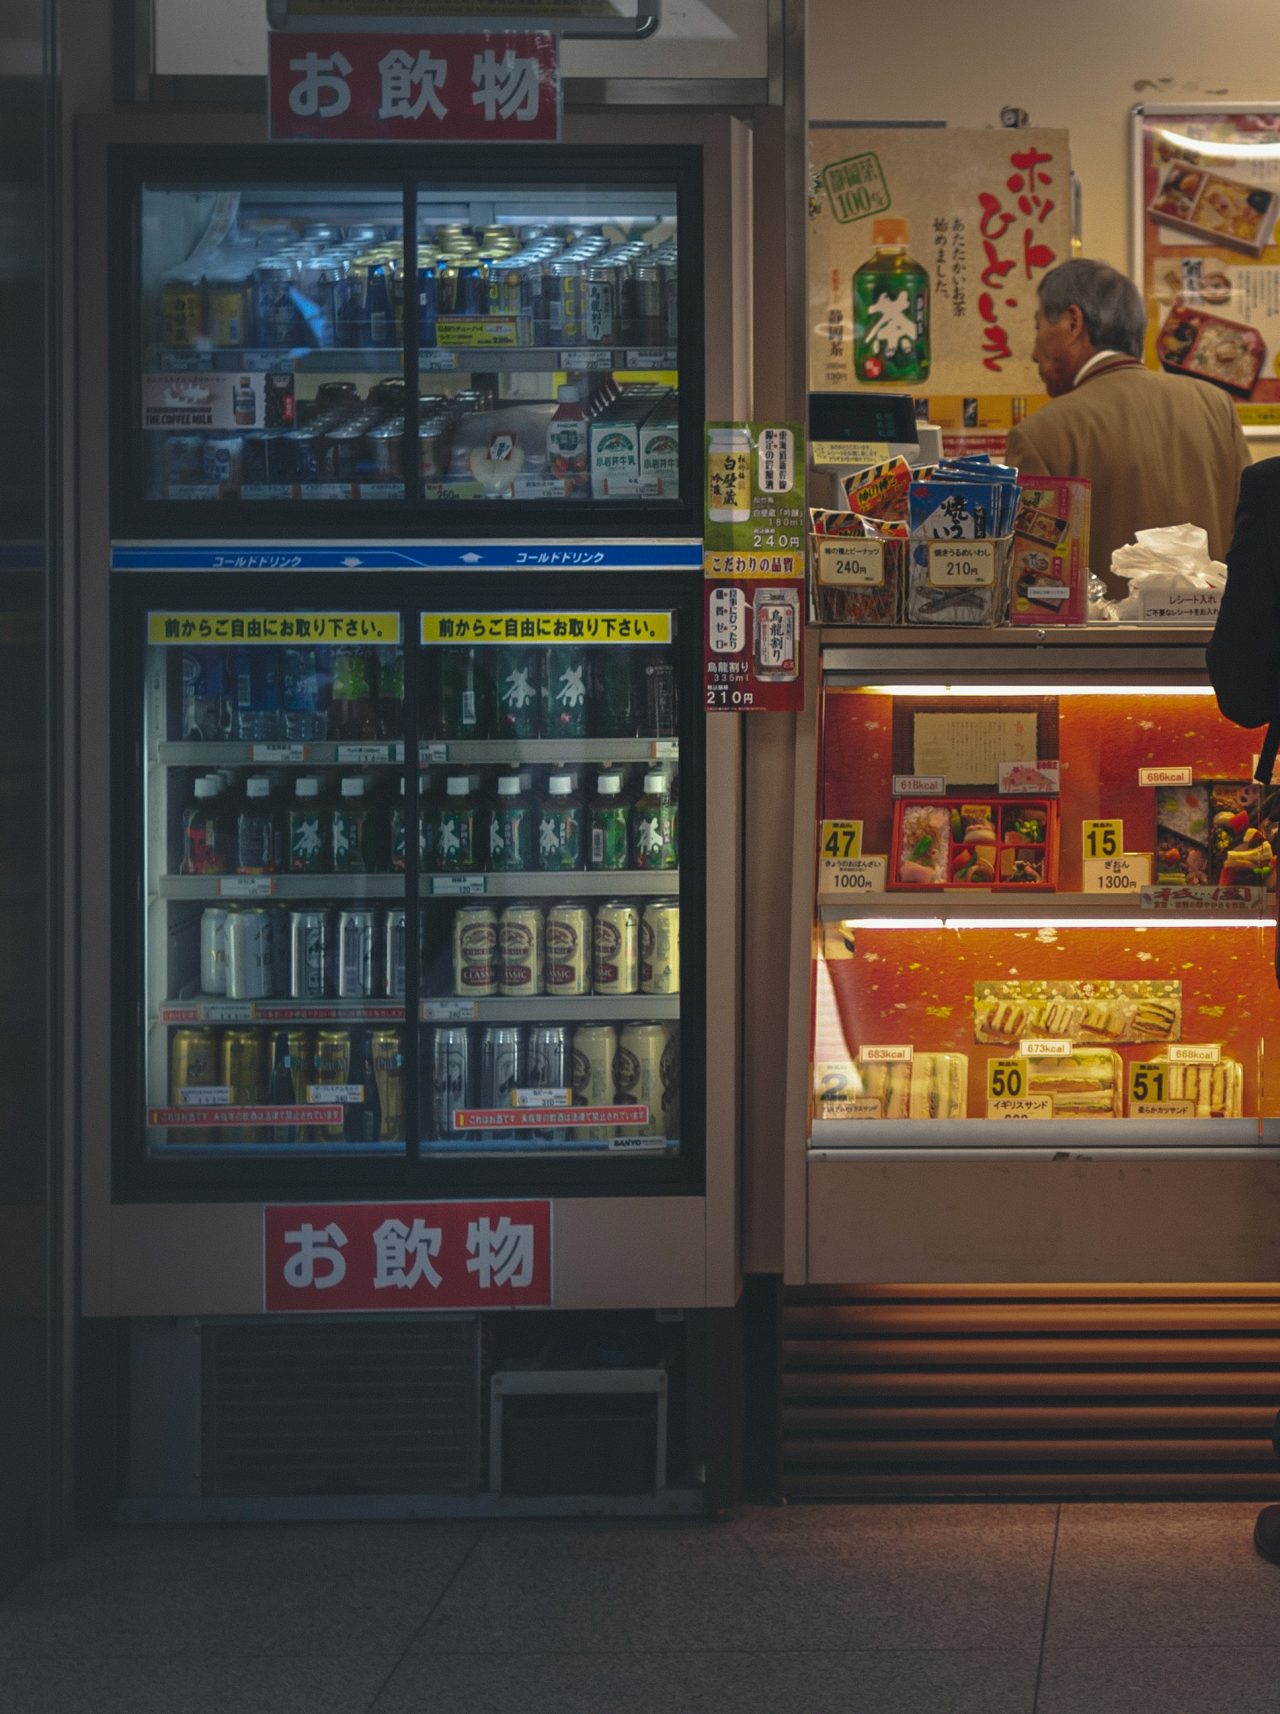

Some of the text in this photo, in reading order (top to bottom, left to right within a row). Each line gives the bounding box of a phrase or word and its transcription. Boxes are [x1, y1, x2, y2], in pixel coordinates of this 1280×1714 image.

[288, 50, 541, 121] お飲物
[1006, 147, 1057, 281] ホット
[932, 216, 951, 299] 始めました。
[951, 217, 967, 318] あたたかいお茶
[864, 290, 917, 357] 茶
[828, 309, 845, 357] 静岡茶
[162, 415, 190, 425] COFFEE
[192, 415, 213, 425] MILK
[753, 535, 801, 548] 240円
[212, 555, 302, 568] コールドドリンク
[516, 550, 605, 564] コールドドリンク
[713, 557, 794, 573] こだわりの品質
[836, 560, 867, 575] 240円
[946, 561, 979, 576] 210円
[1169, 595, 1216, 606] レシート入れ
[164, 617, 385, 639] 前からご自由にお取り下さい。
[438, 616, 658, 639] 前からご自由にお取り下さい。
[770, 609, 785, 663] 烏龍割り
[708, 662, 750, 673] 烏龍割り
[707, 691, 754, 704] 210円
[900, 780, 938, 790] 618kcal
[1147, 773, 1185, 782] 686kcal
[825, 830, 856, 858] 47
[1087, 829, 1117, 857] 15
[1105, 860, 1130, 869] ぎおん
[834, 874, 873, 889] 1000円
[1098, 875, 1137, 889] 1300円
[868, 1050, 906, 1059] 683kcal
[1027, 1044, 1065, 1053] 673kcal
[1176, 1050, 1214, 1060] 668kcal
[820, 1073, 849, 1101] 2
[991, 1069, 1022, 1097] 50
[1132, 1072, 1164, 1100] 51
[993, 1101, 1049, 1111] イギリスサンド
[1138, 1106, 1189, 1115] 柔らかカツサンド
[614, 1139, 641, 1147] SANYO
[283, 1216, 534, 1290] お飲物
